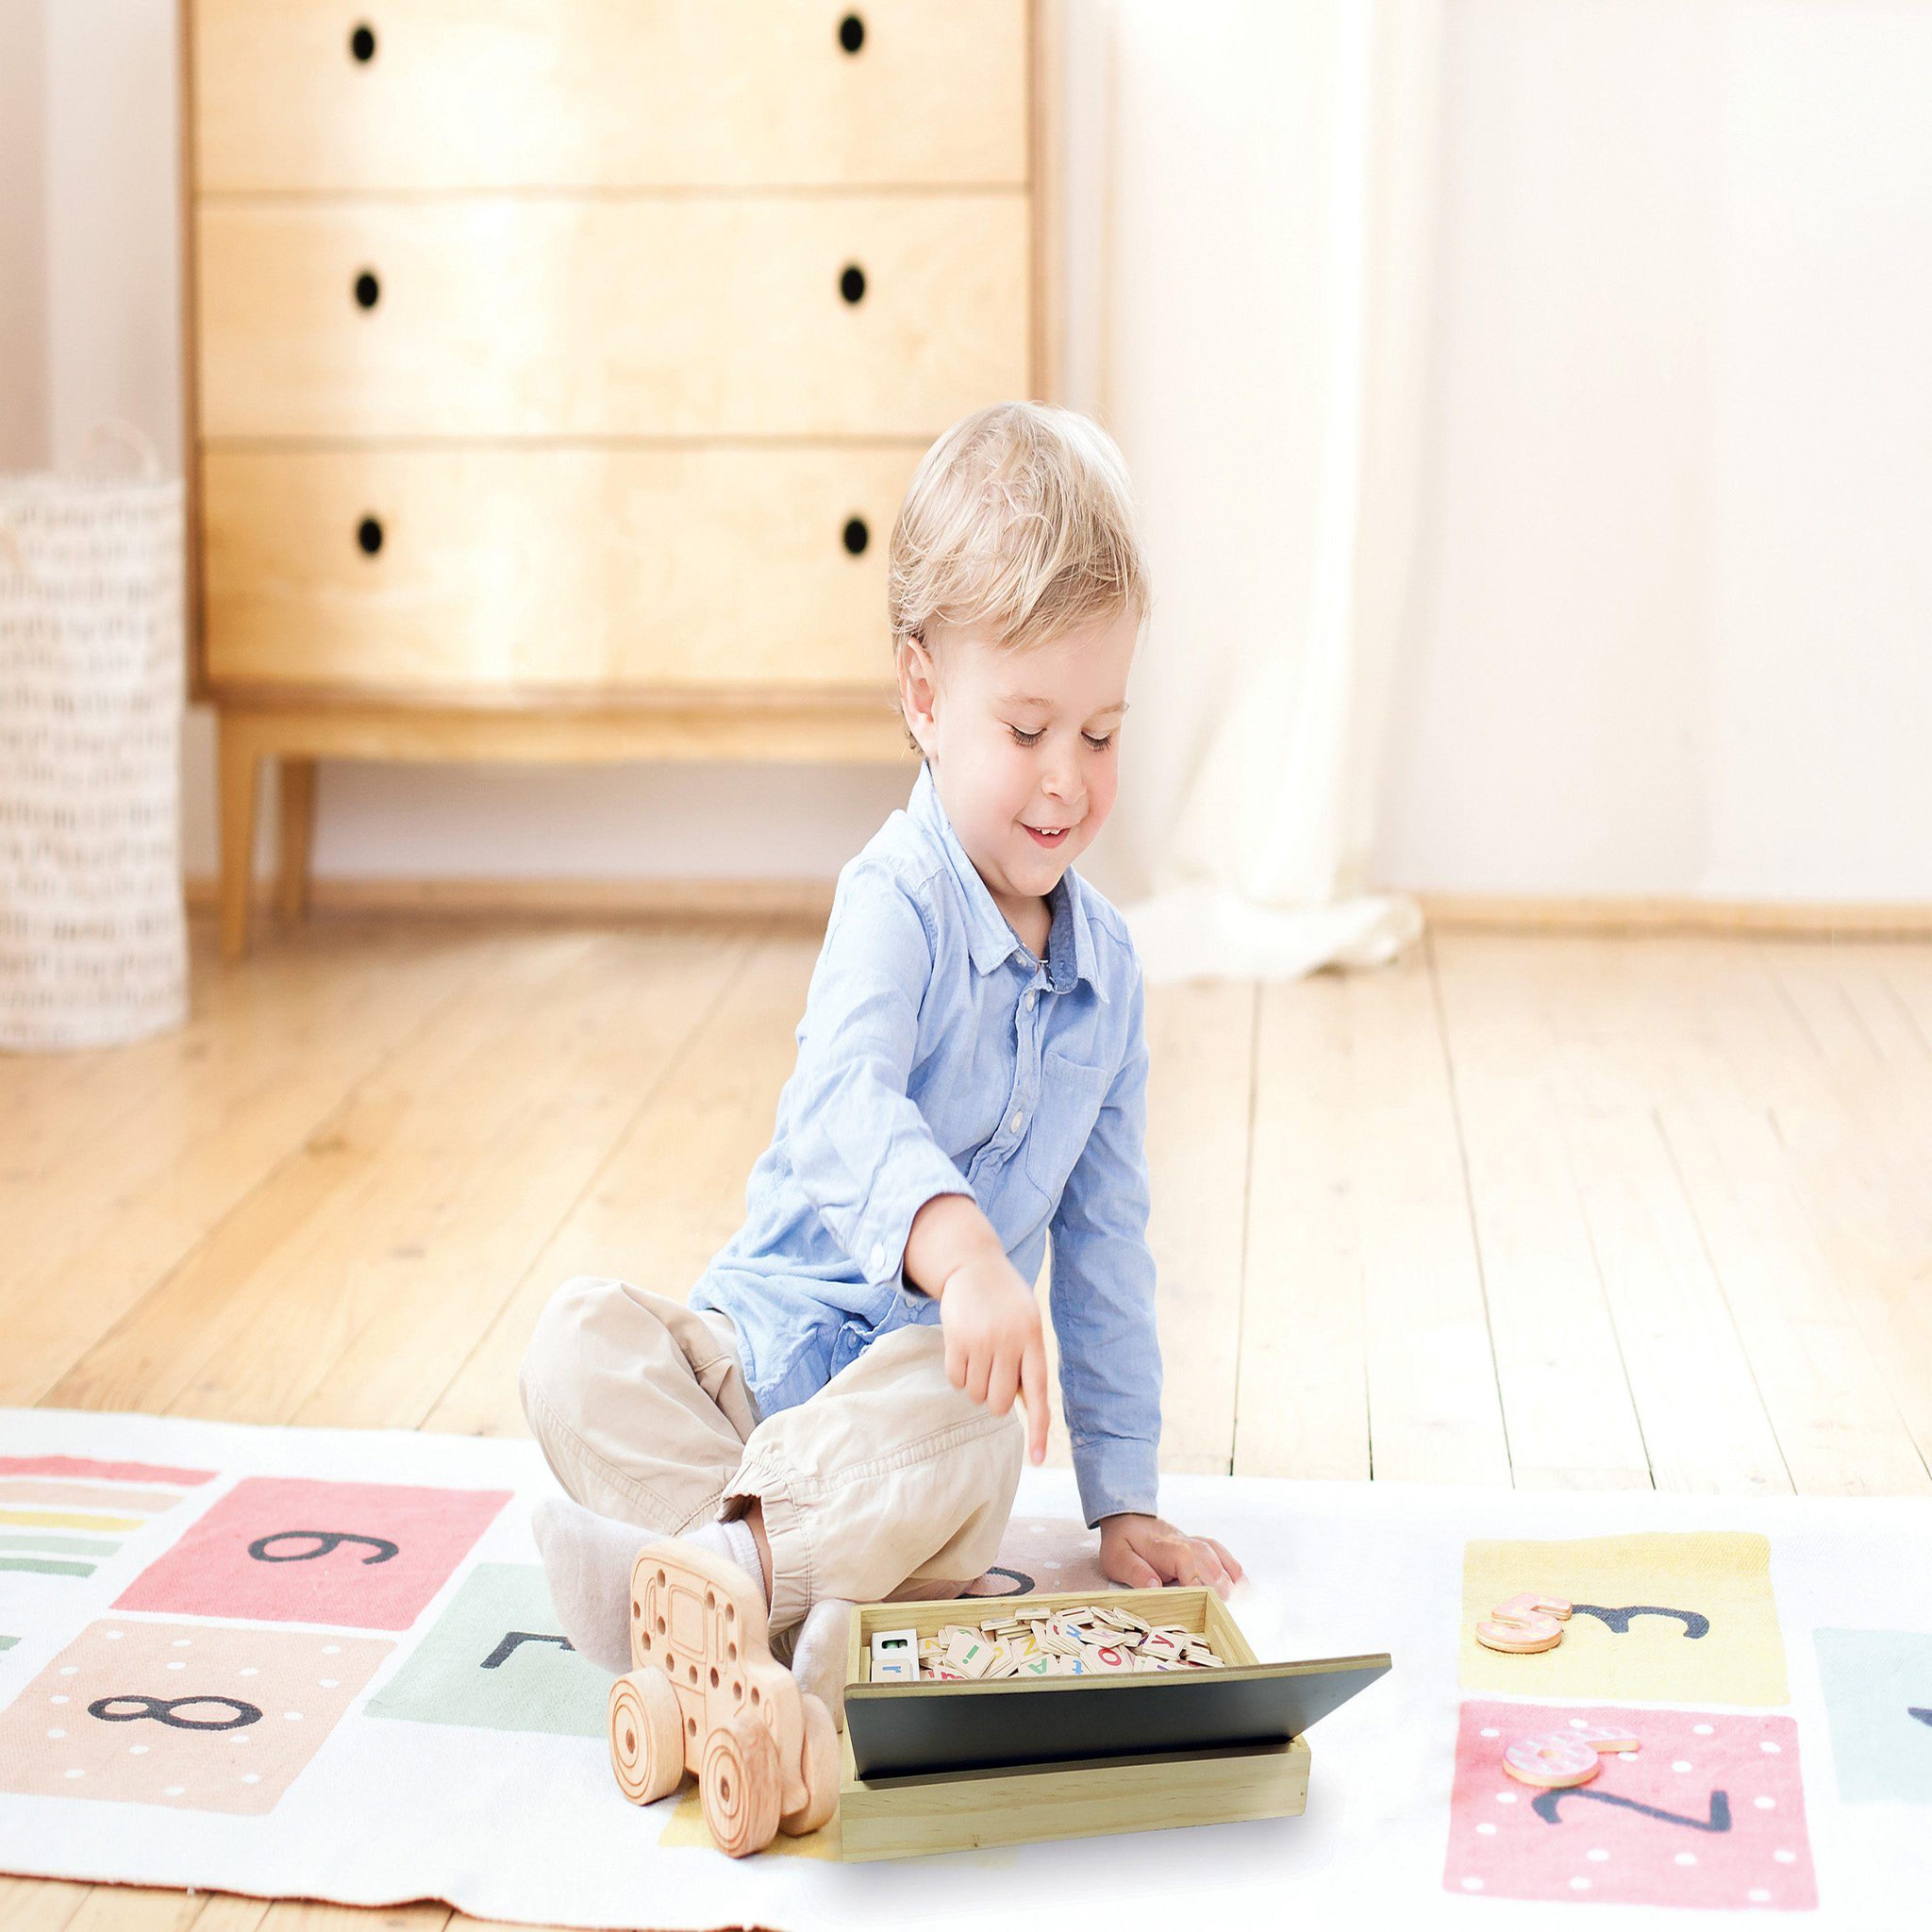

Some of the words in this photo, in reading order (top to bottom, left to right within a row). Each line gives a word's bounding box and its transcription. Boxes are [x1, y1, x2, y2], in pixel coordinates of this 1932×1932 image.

[248, 1530, 399, 1565] 9
[1572, 1604, 1710, 1638] 3
[1027, 1657, 1048, 1674] A
[88, 1695, 263, 1731] 8
[1531, 1786, 1732, 1833] 2
